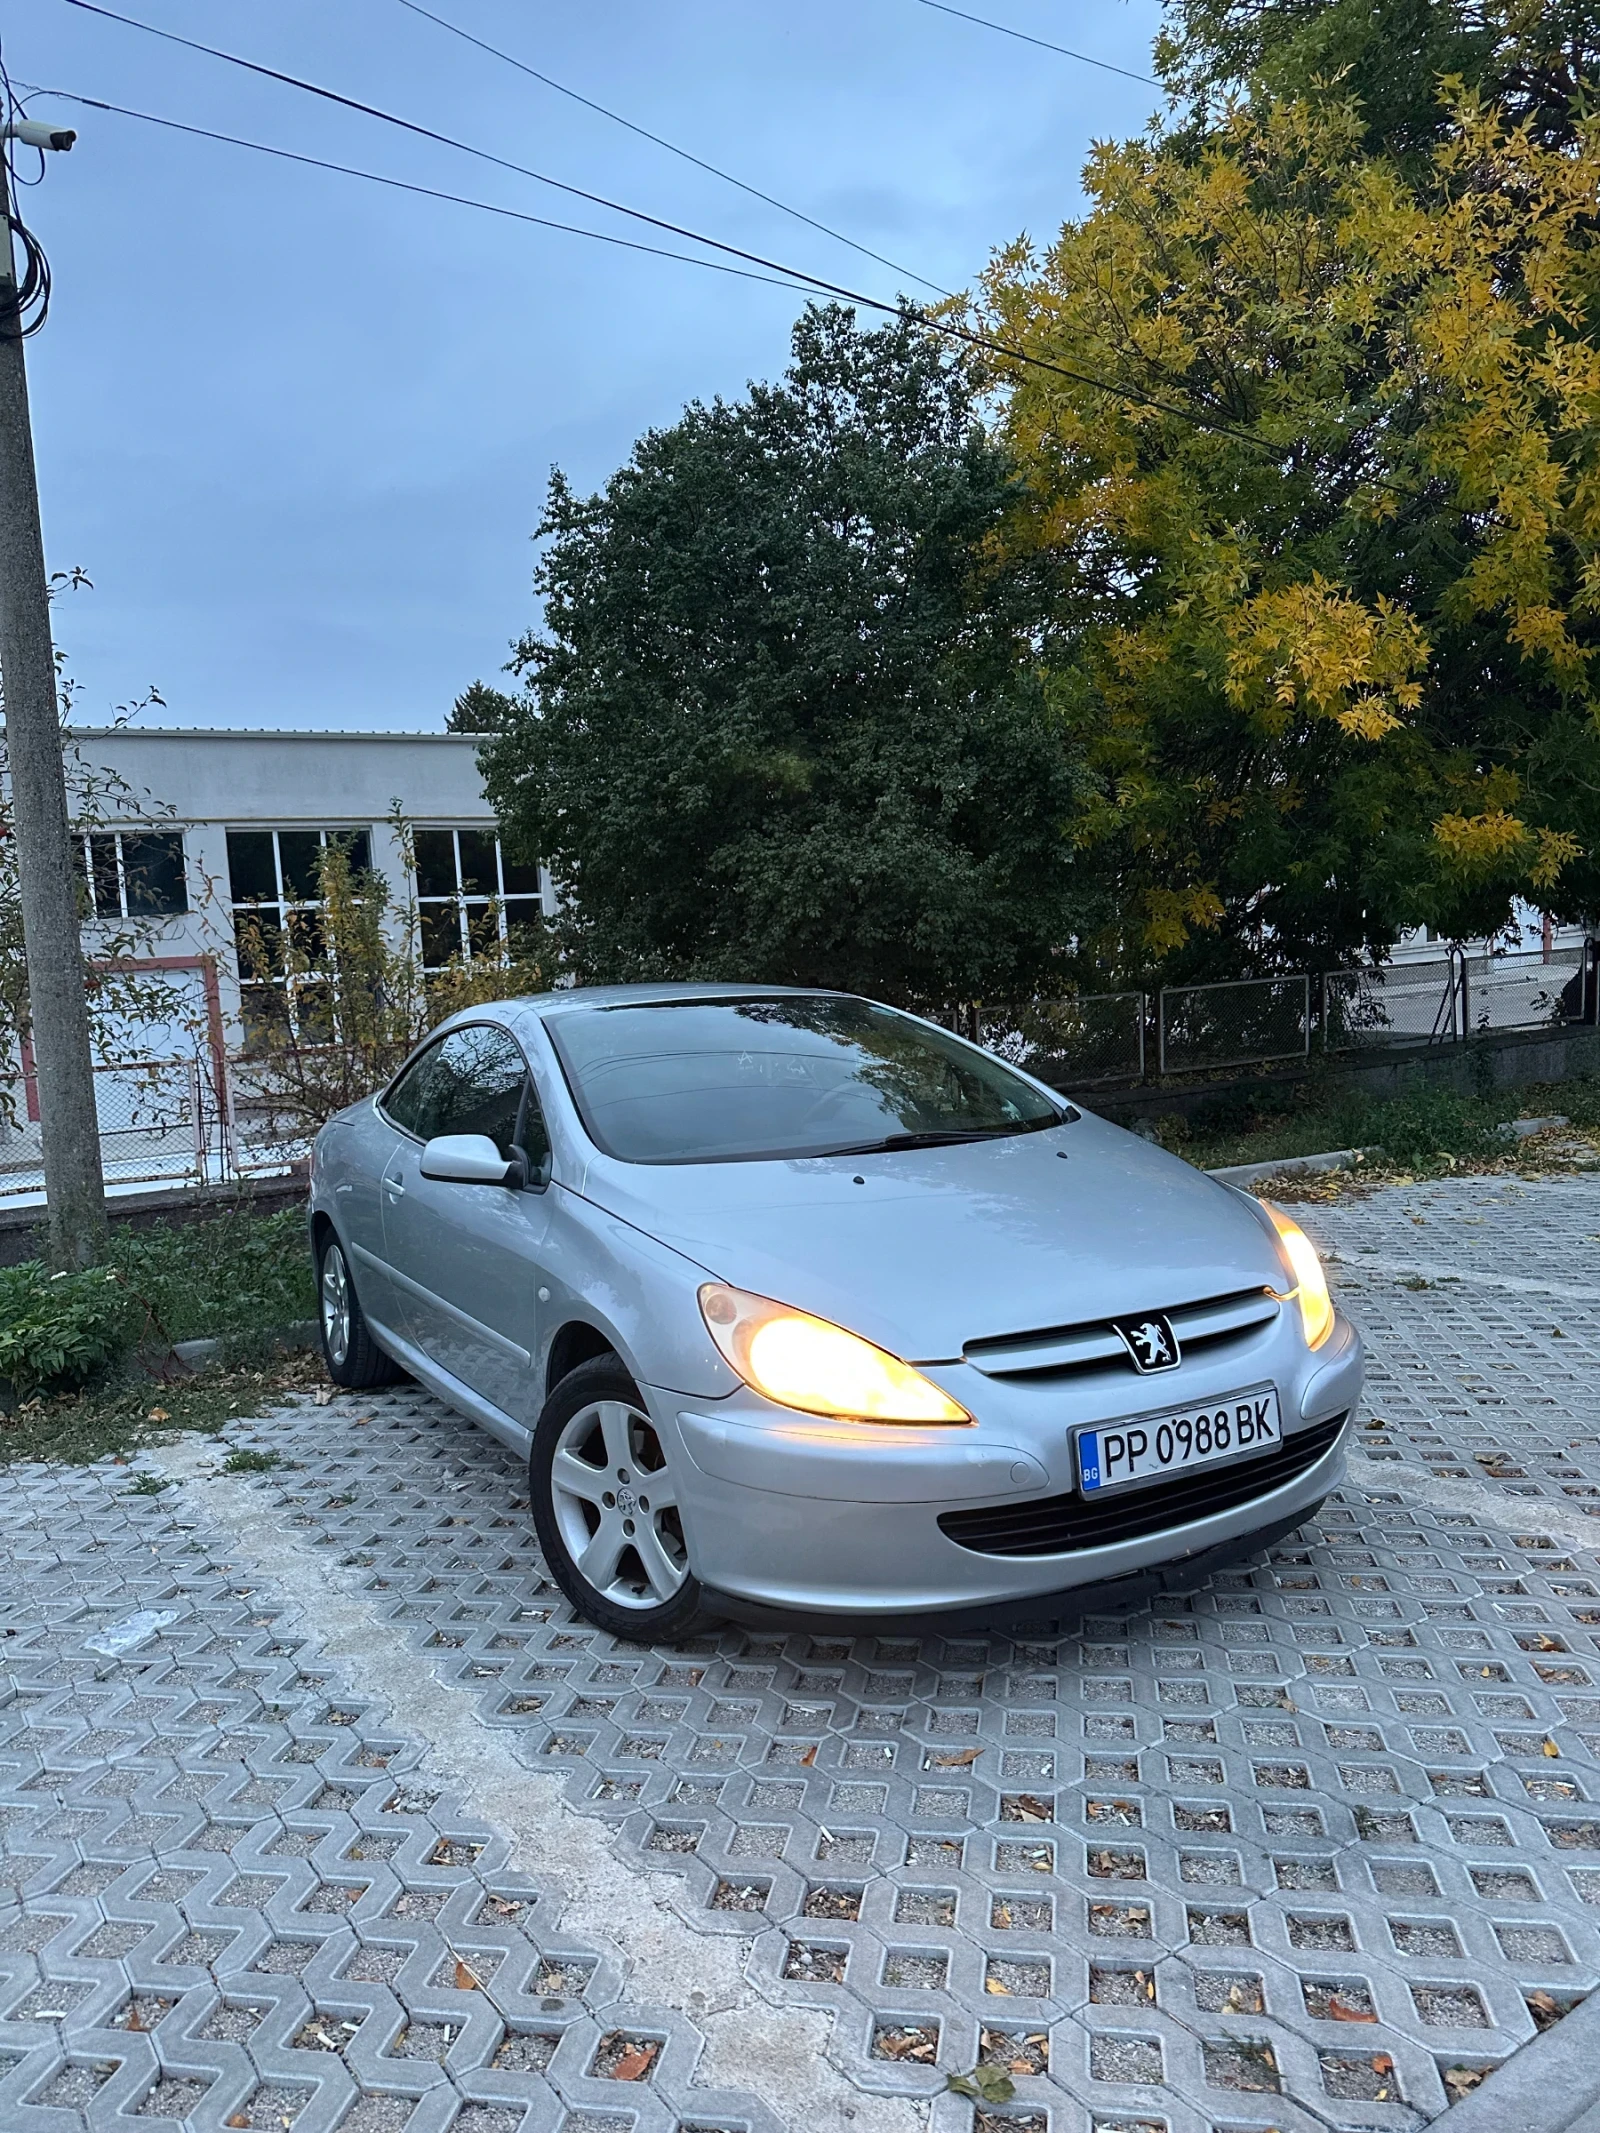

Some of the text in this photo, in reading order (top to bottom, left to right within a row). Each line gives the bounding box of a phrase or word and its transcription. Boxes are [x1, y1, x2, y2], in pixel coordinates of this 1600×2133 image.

[1104, 1398, 1274, 1478] PP 0988 BK
[1083, 1467, 1098, 1482] BG
